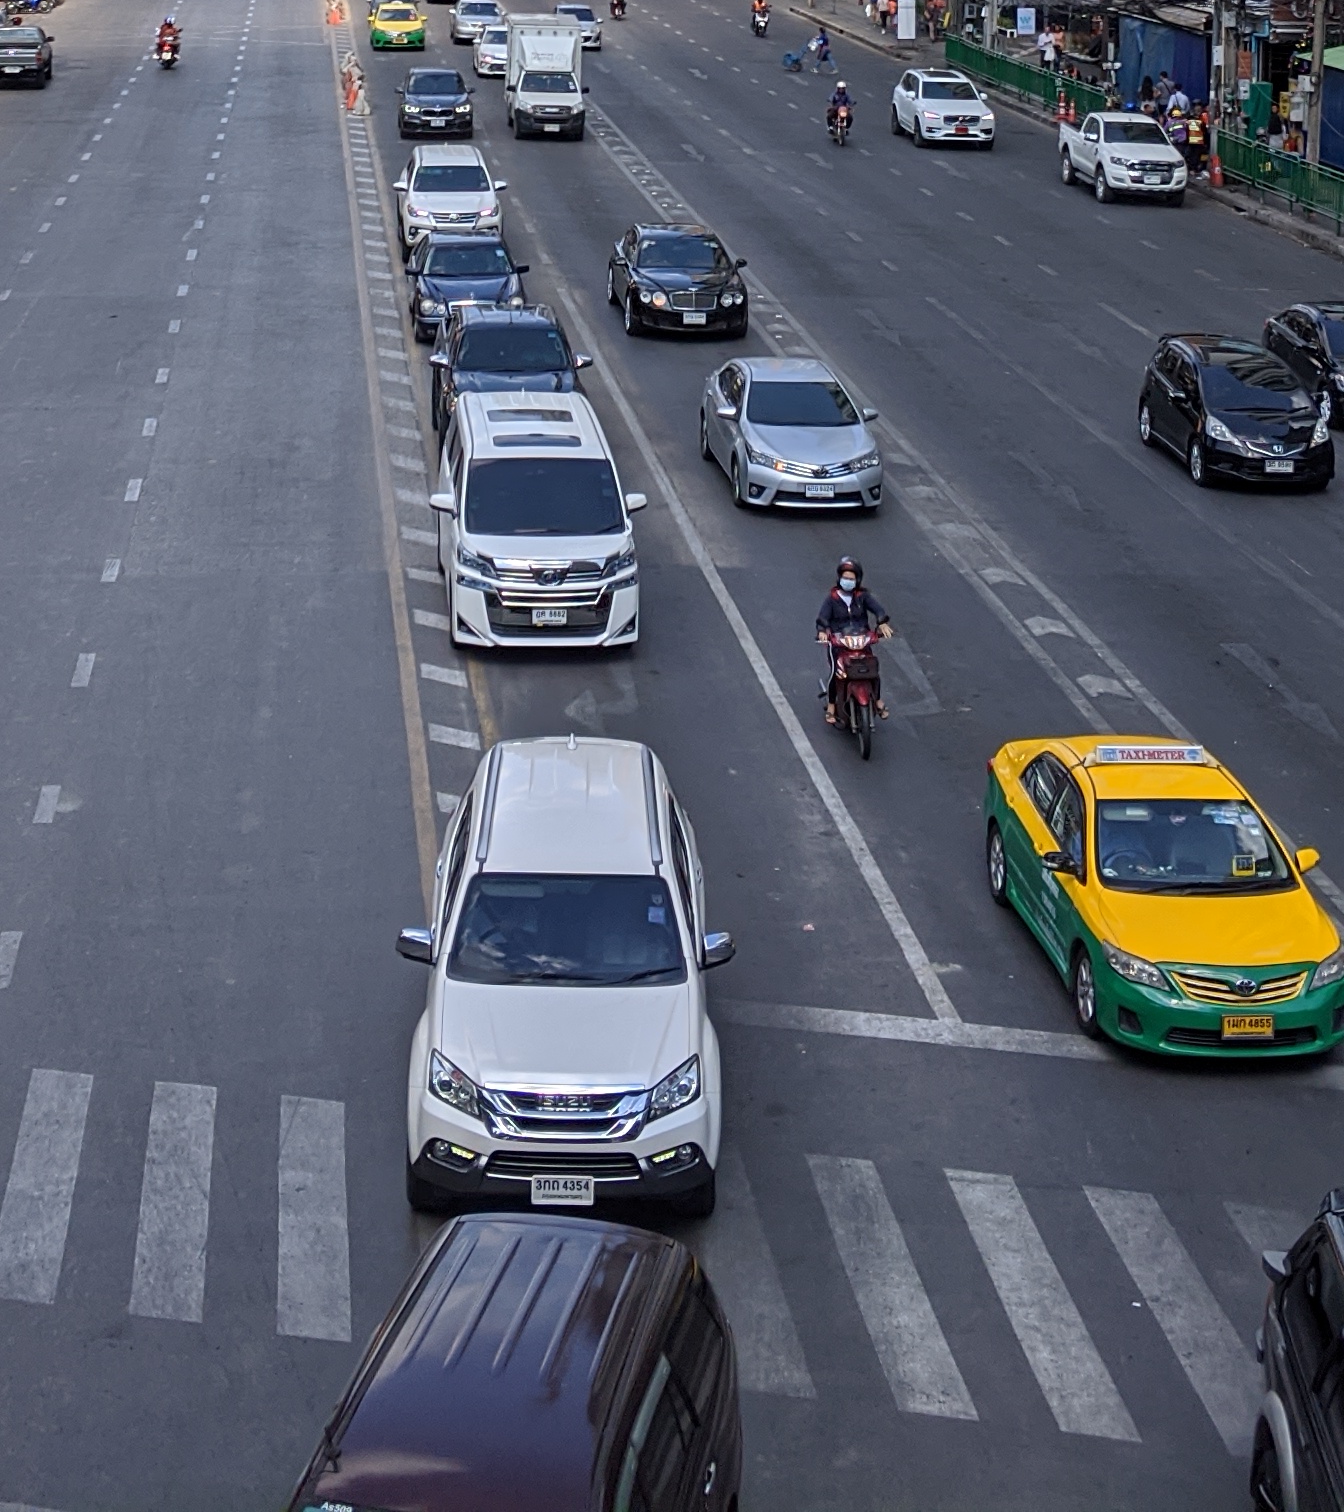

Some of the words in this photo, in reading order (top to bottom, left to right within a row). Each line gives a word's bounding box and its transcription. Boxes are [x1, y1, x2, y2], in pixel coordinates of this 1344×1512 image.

[1119, 749, 1186, 760] TAXI-METER
[538, 1095, 592, 1107] ISUZU
[562, 1179, 590, 1191] 4354
